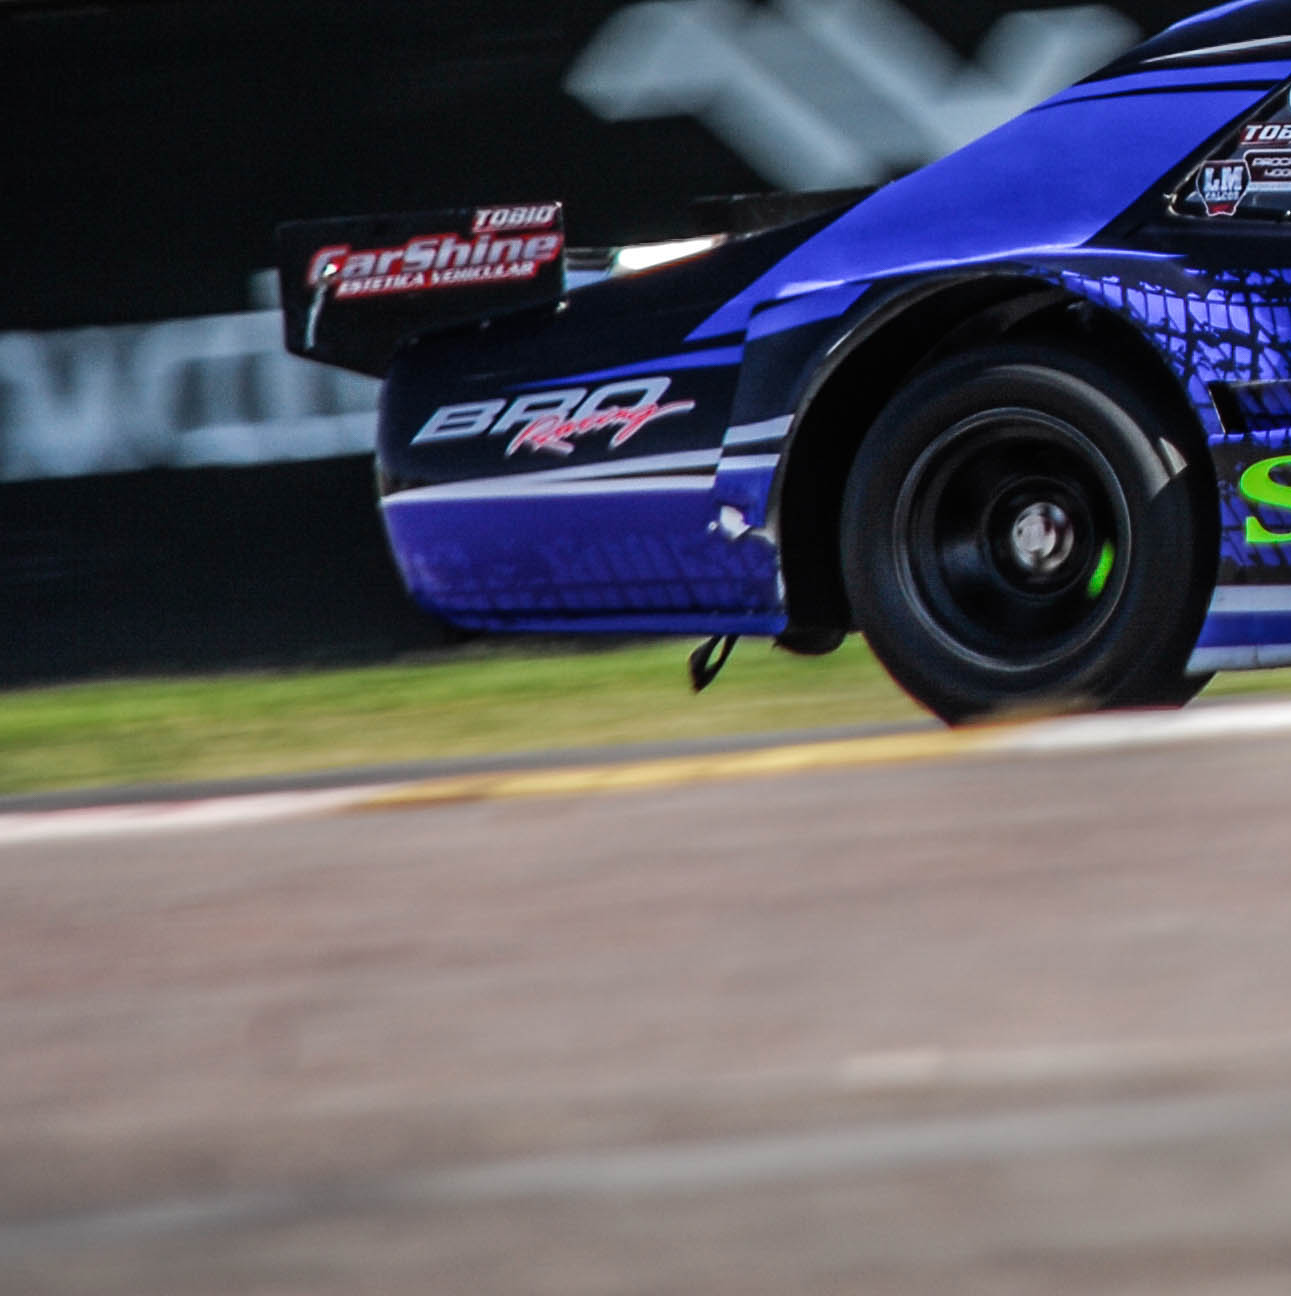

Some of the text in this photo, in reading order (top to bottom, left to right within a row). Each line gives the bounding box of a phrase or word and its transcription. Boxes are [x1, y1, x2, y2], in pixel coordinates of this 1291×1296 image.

[1203, 166, 1244, 192] LM
[475, 205, 557, 228] TOBIO
[308, 233, 559, 286] CarShine
